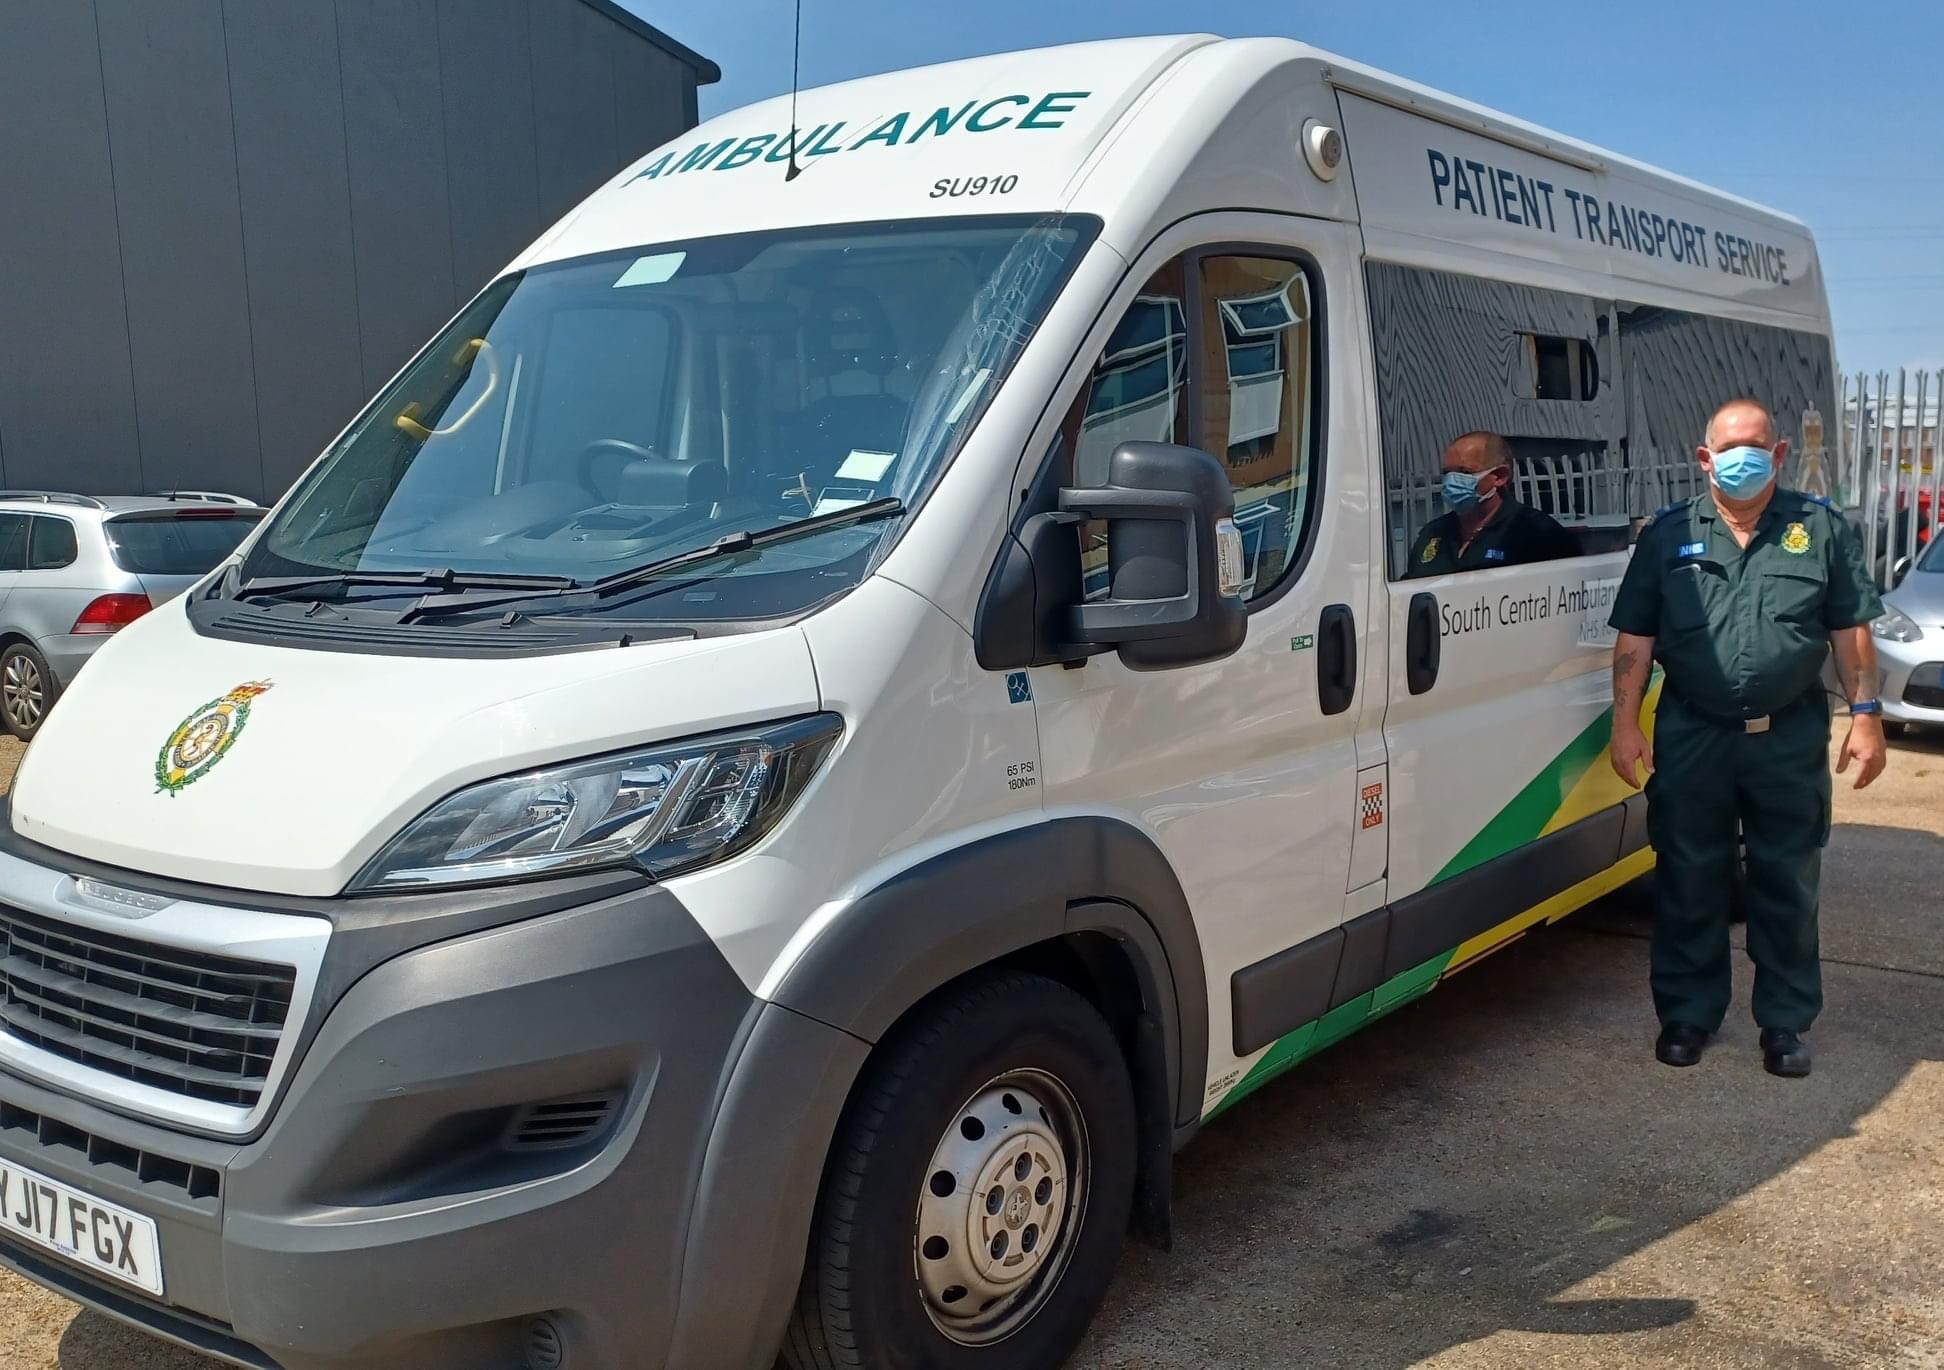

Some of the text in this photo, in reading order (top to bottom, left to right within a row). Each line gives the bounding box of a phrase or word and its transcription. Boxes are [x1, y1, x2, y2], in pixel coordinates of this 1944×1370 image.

[619, 91, 1092, 188] AMBULANCE
[929, 174, 1019, 199] SU910
[1427, 148, 1791, 286] PATIENT TRANSPORT SERVICE
[1441, 578, 1621, 636] South Central Ambulan
[1007, 760, 1035, 776] 65 PSI
[1007, 776, 1036, 790] 180Nm
[68, 1196, 139, 1276] FGX
